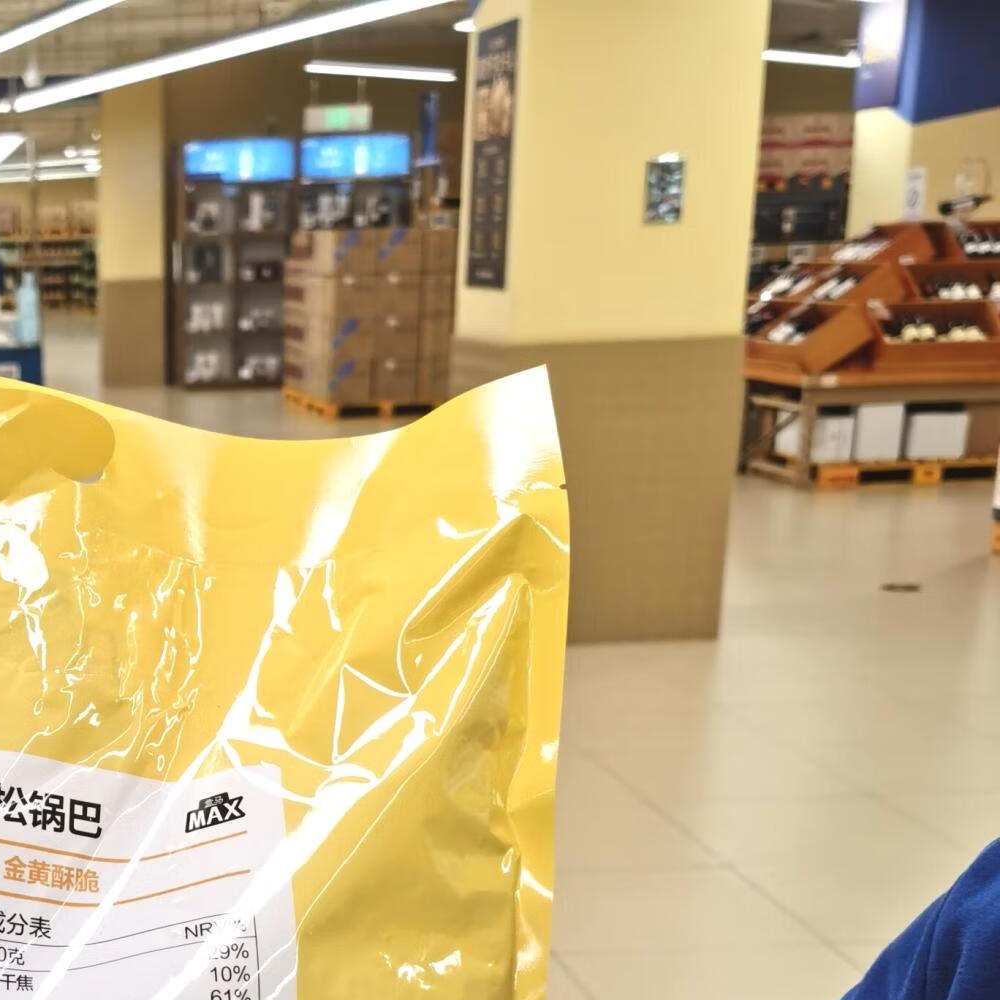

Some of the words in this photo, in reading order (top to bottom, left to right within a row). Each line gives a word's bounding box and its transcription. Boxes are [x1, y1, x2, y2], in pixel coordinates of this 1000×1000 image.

[188, 799, 242, 831] MAX
[3, 855, 99, 893] 金黄酥脆
[184, 919, 247, 939] NR
[208, 942, 250, 960] 9%
[210, 964, 251, 983] 10%
